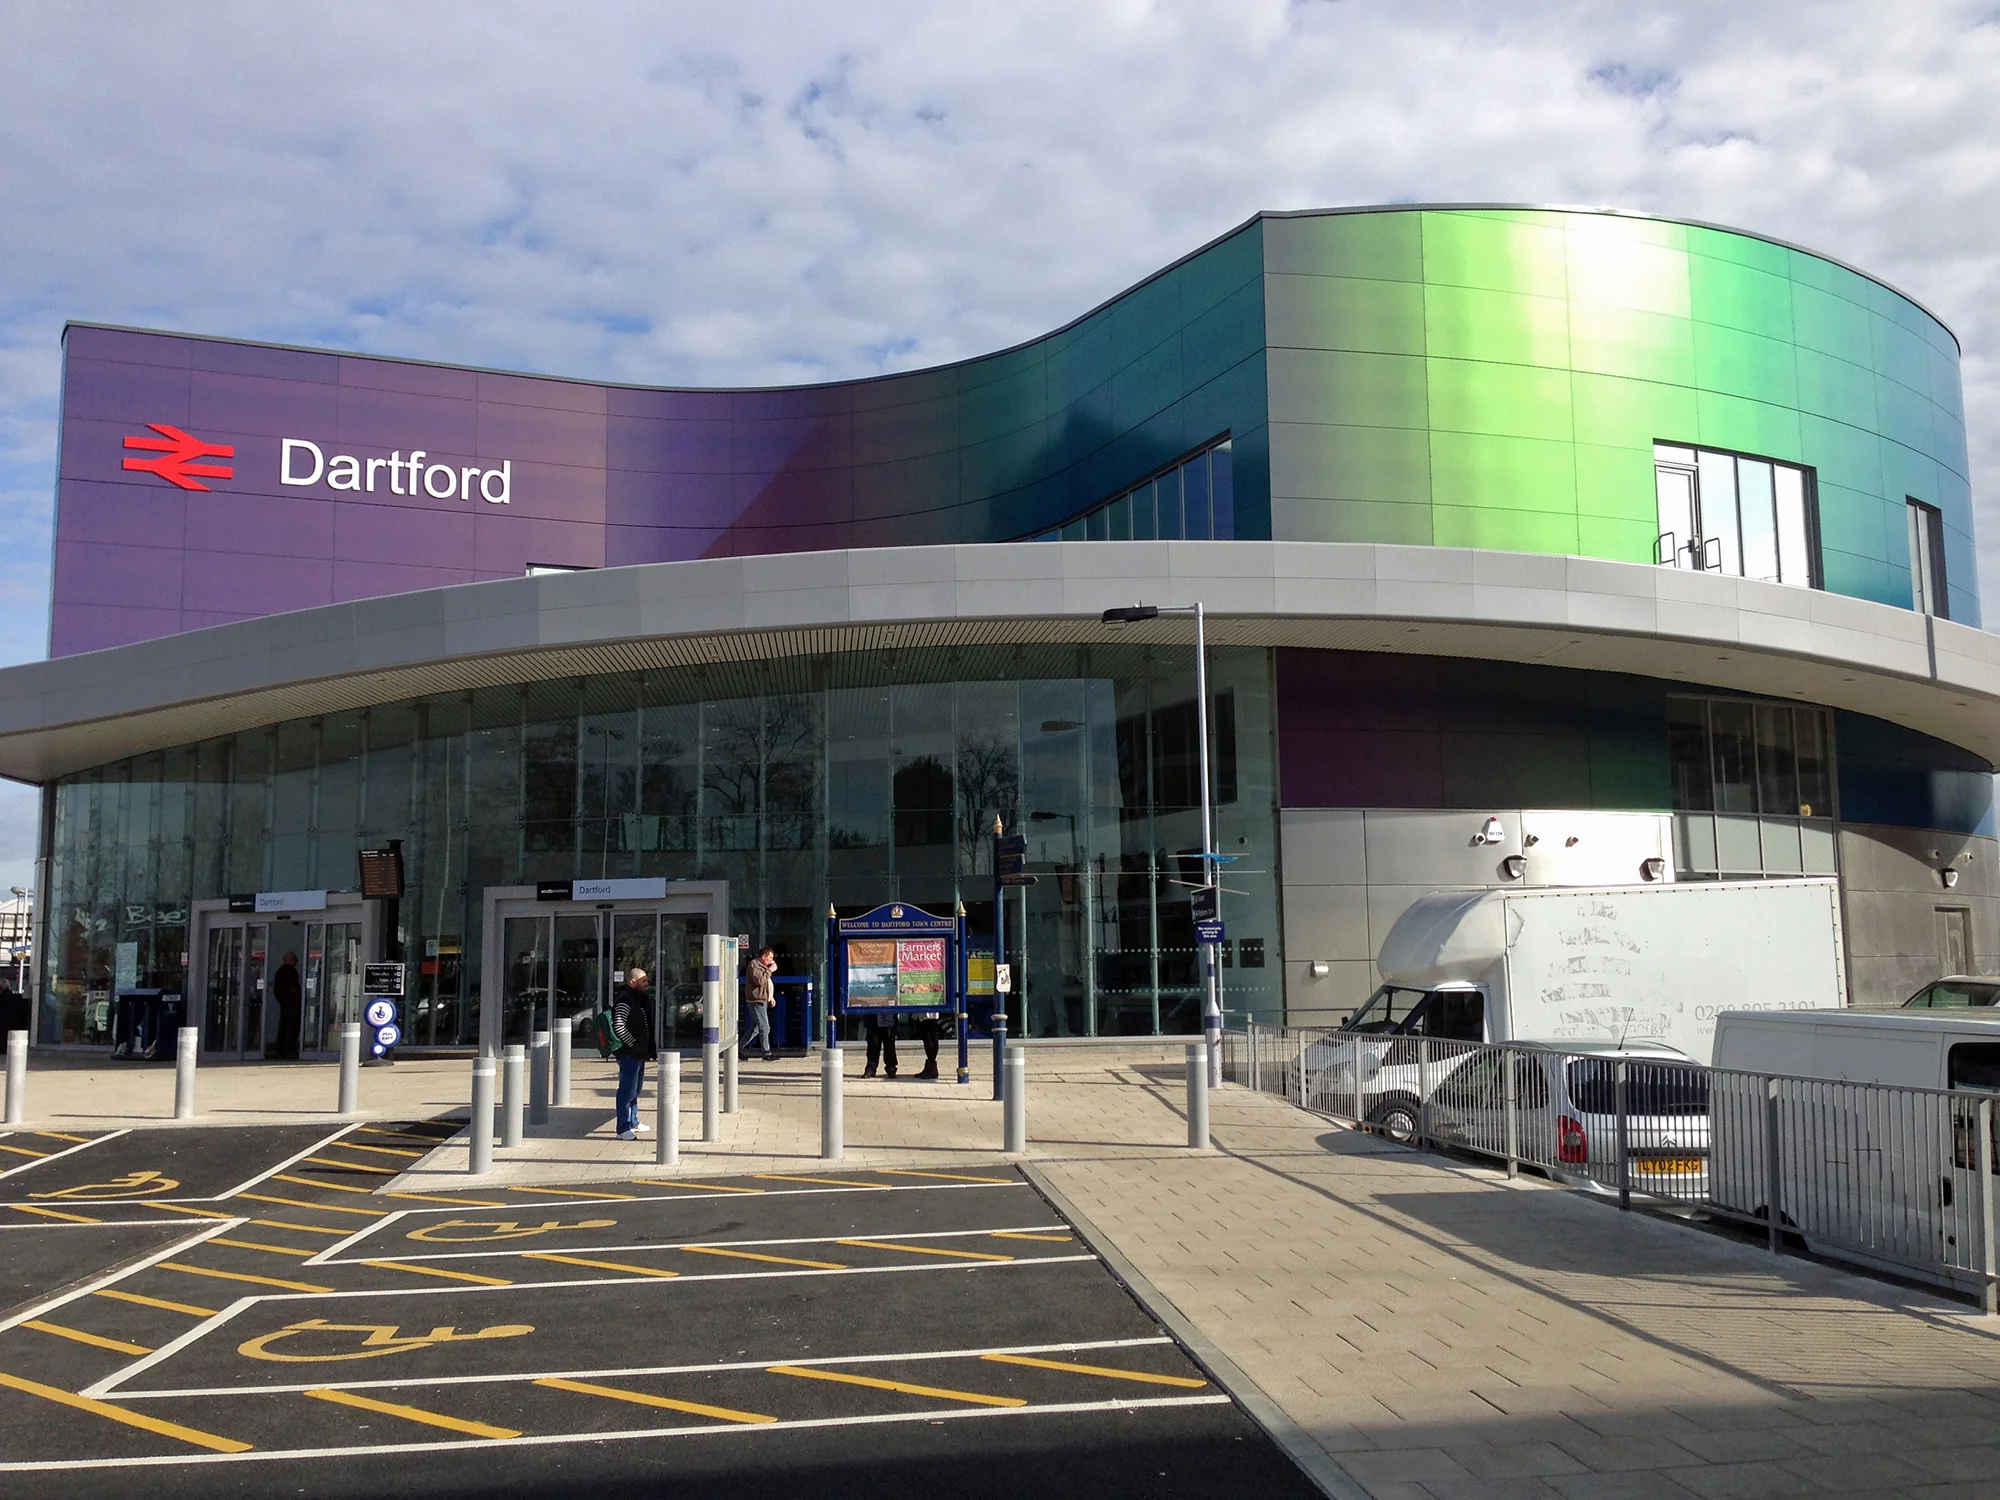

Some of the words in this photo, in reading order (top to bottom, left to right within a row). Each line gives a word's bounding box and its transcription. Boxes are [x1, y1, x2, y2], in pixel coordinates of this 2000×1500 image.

[280, 438, 511, 504] Dartford
[579, 886, 611, 894] Dartford
[260, 898, 285, 907] Dartford
[901, 942, 942, 952] Farmers
[901, 951, 942, 961] Market
[1675, 1159, 1699, 1171] FKG
